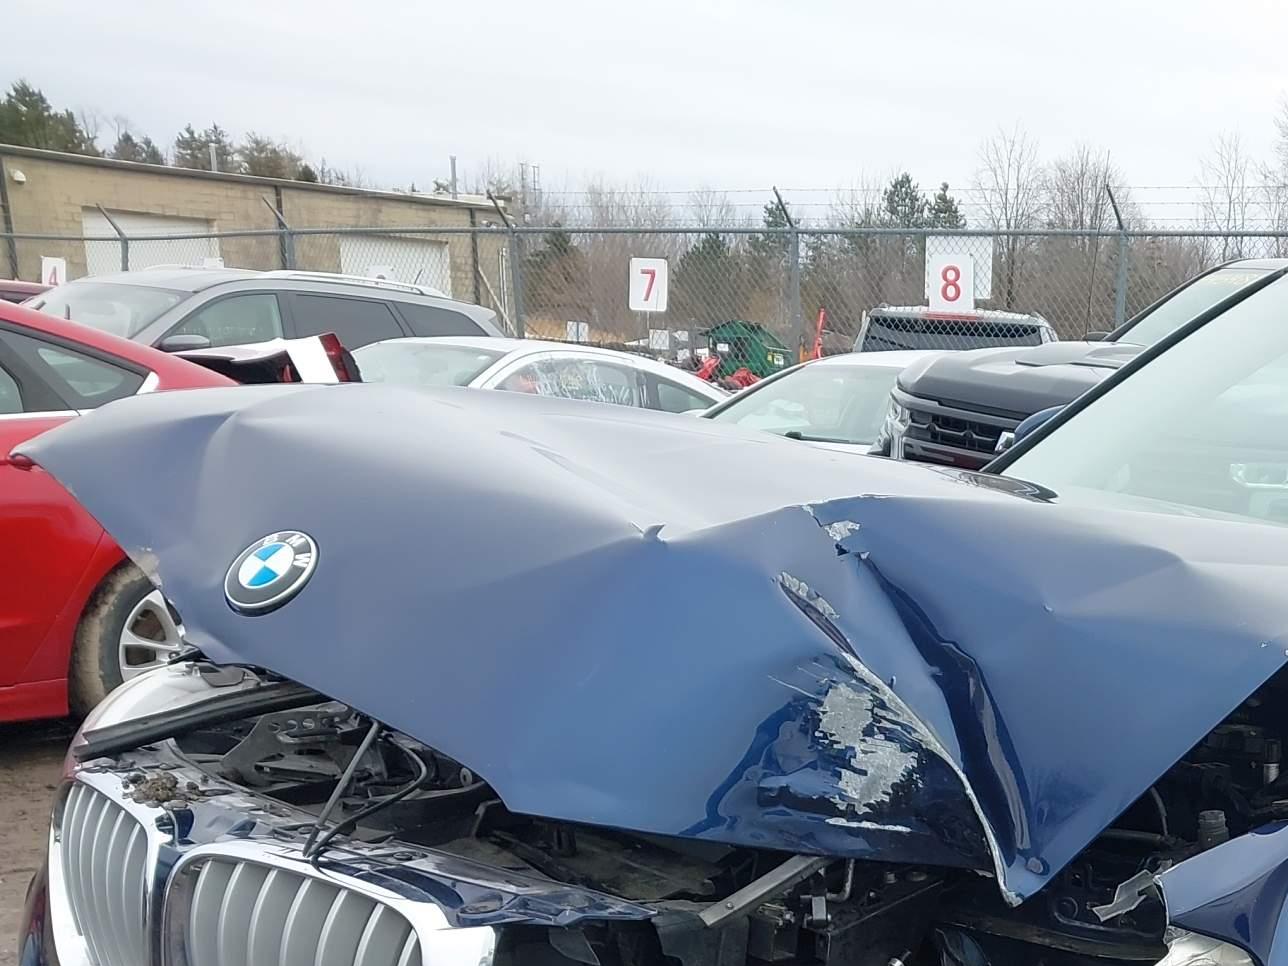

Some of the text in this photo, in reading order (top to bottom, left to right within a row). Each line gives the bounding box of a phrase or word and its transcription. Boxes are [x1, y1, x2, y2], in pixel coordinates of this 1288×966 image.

[640, 269, 656, 301] 7
[941, 264, 961, 302] 8
[262, 533, 311, 568] BMW
